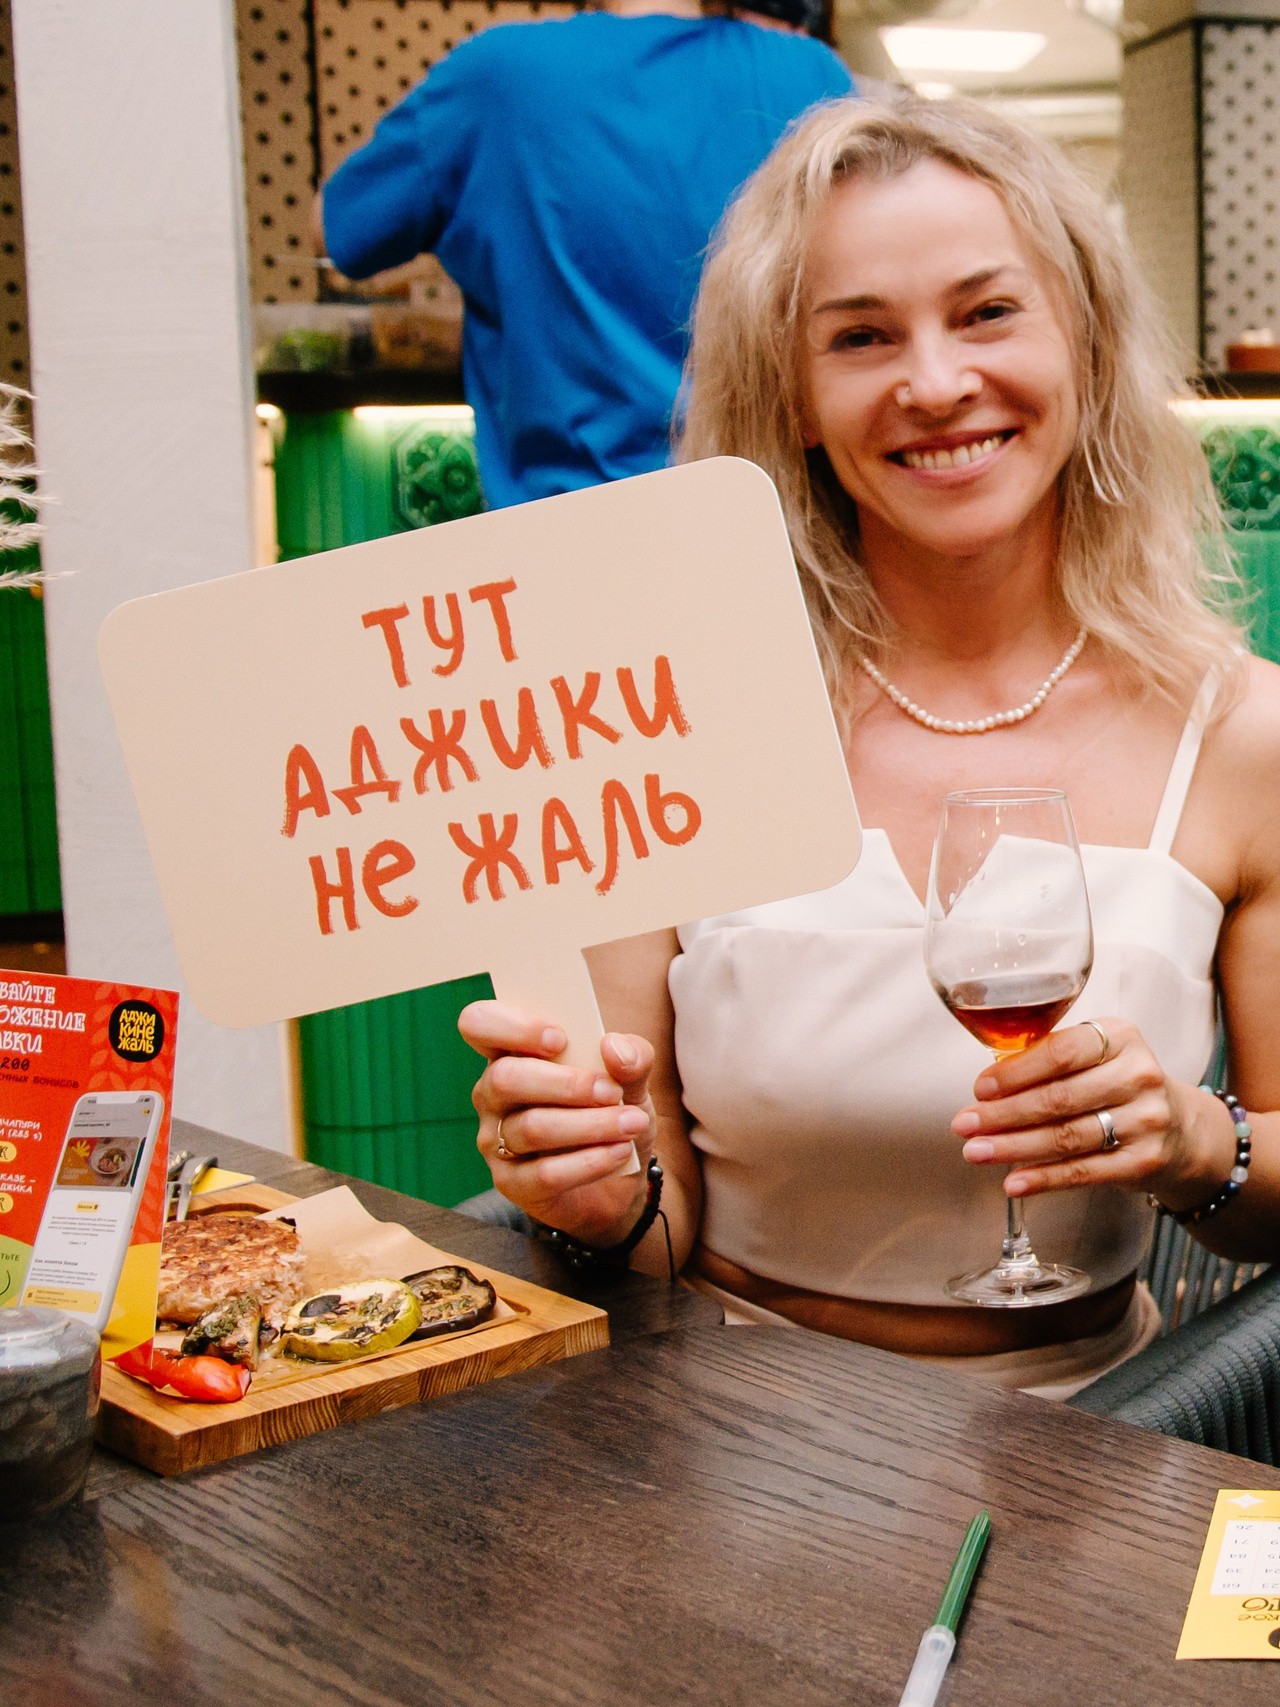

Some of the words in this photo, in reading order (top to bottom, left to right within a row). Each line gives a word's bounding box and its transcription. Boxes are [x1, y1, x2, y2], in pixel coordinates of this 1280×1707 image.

[361, 576, 518, 688] ТУТ
[280, 655, 692, 838] АДЖИКИ
[447, 773, 702, 904] ЖАЛЬ
[0, 1030, 43, 1055] ВКИ
[1, 1056, 30, 1071] 200
